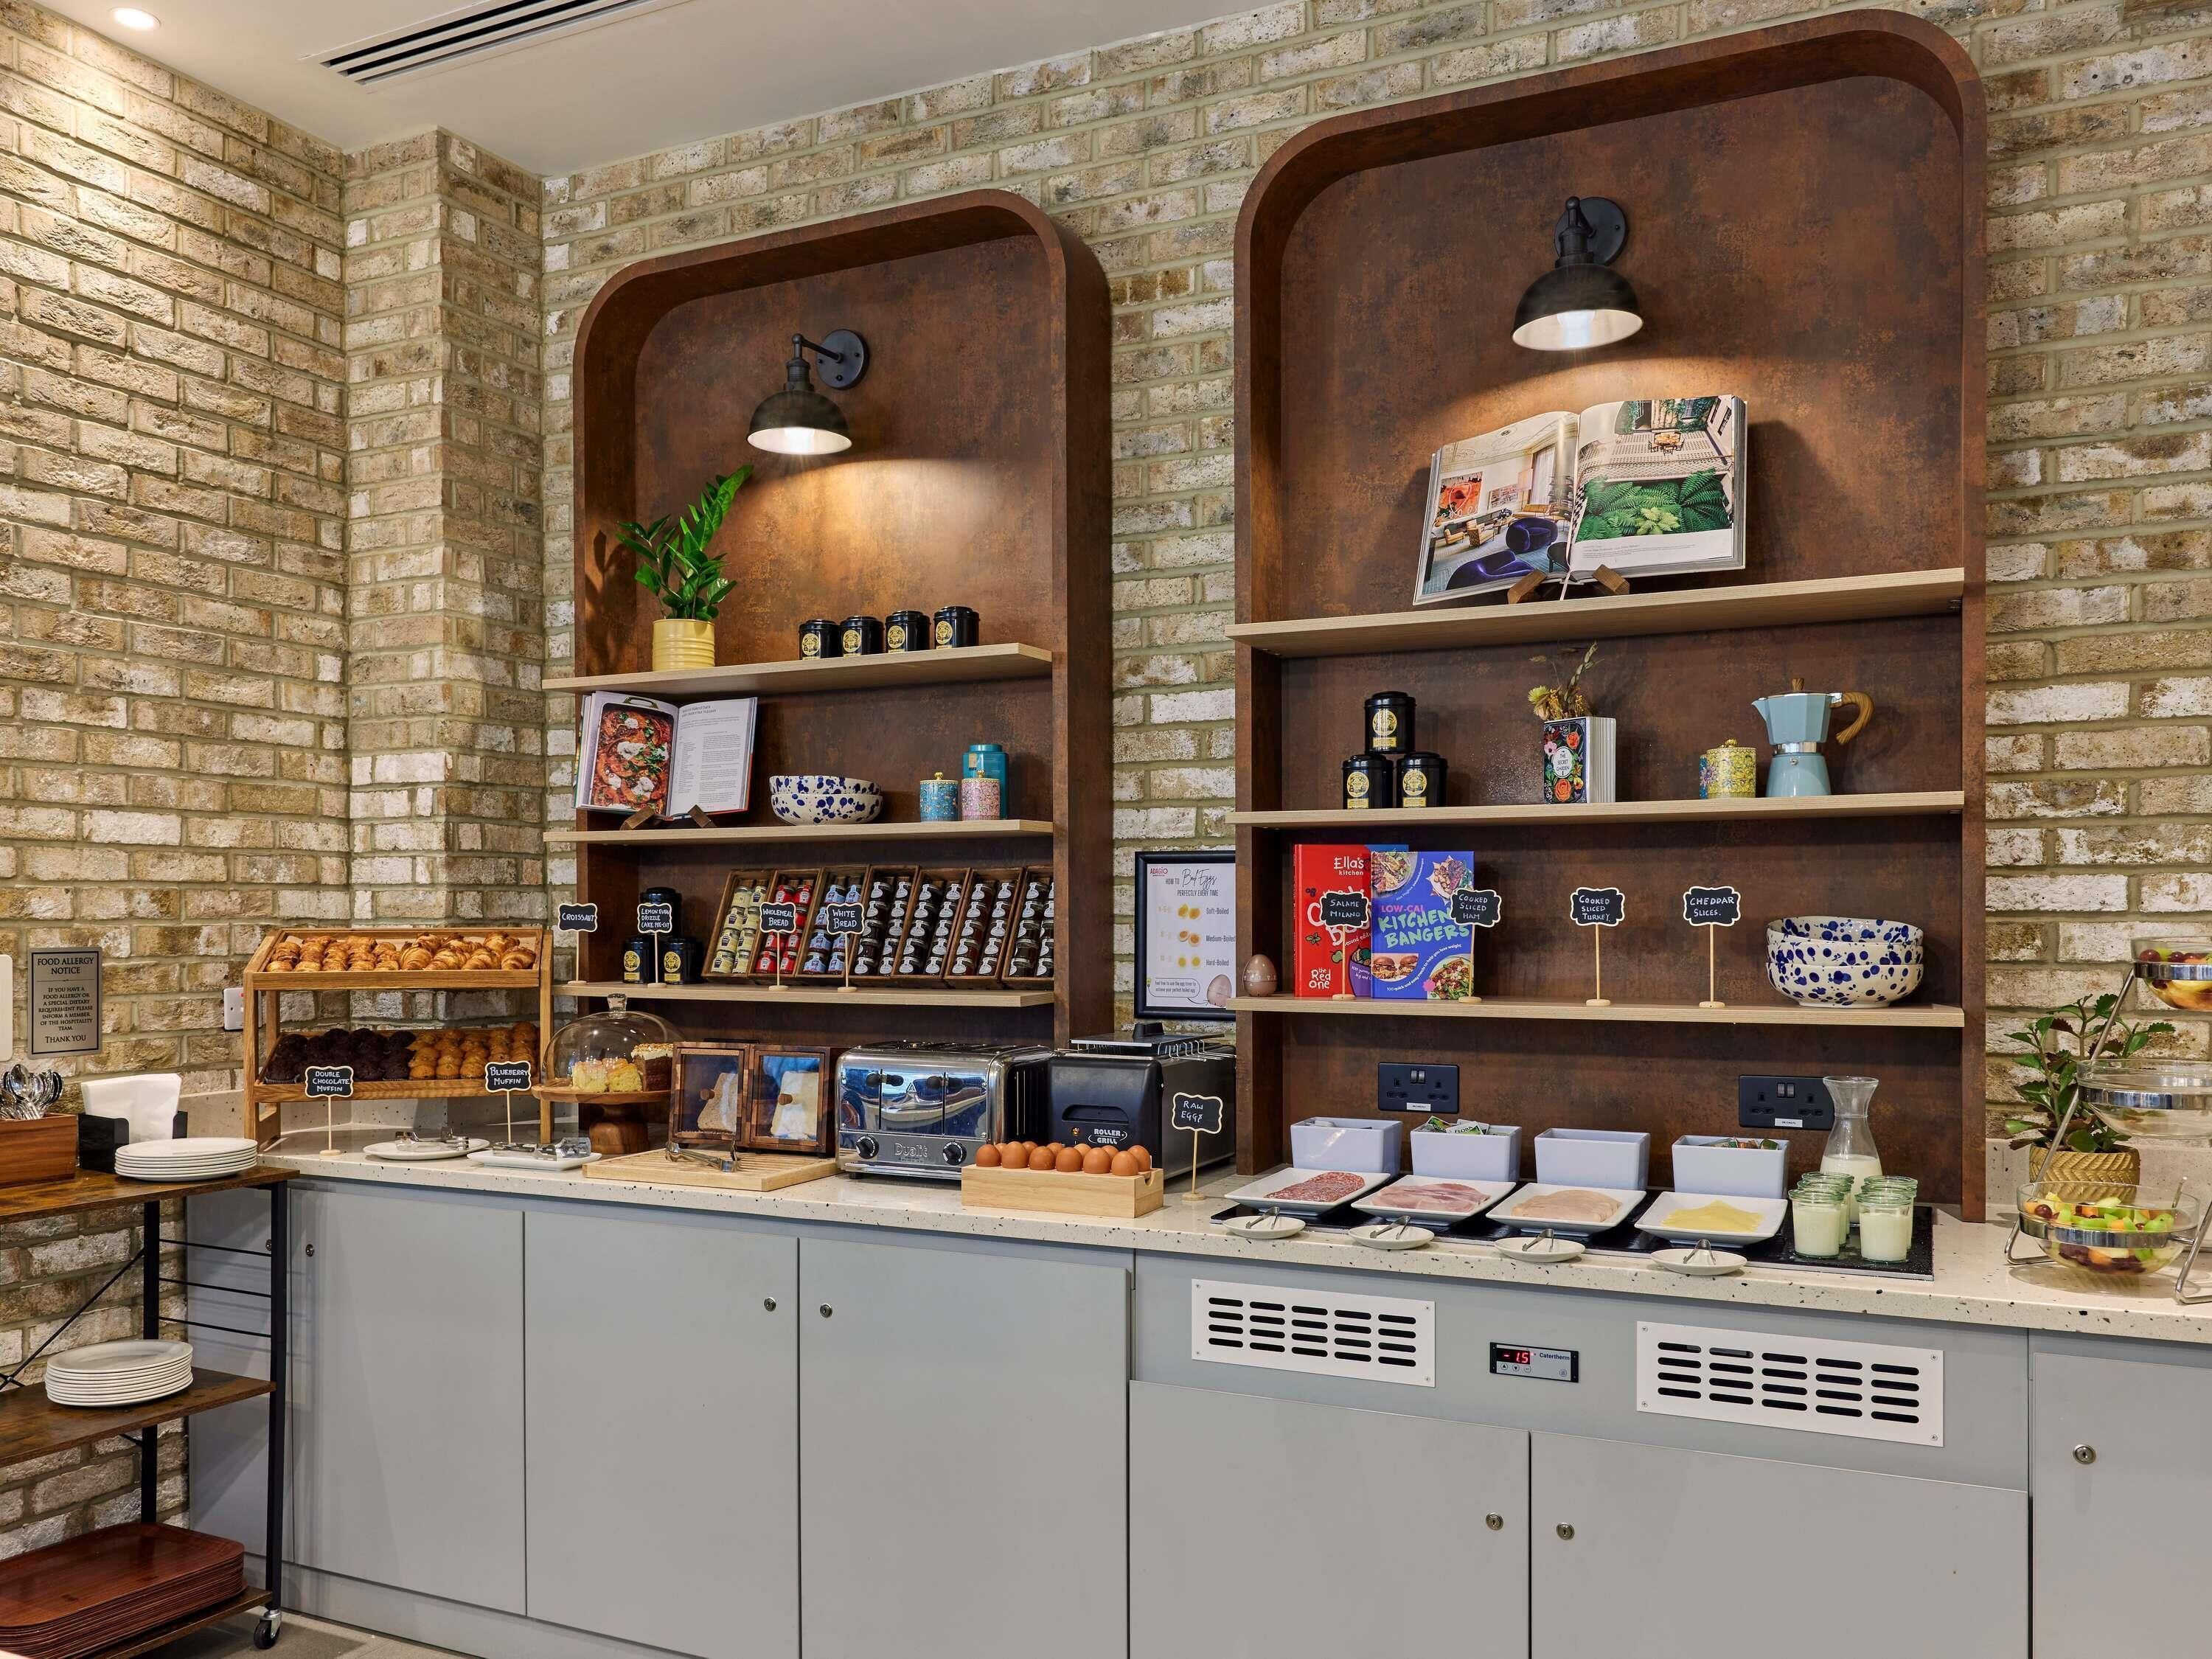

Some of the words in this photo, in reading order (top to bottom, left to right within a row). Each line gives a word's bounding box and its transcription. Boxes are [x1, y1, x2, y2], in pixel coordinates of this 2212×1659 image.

[1334, 855, 1364, 869] Ella's
[1458, 894, 1488, 903] COOKED
[1579, 894, 1610, 905] COOKED
[1689, 897, 1735, 905] CHEDDAR
[1329, 899, 1360, 908] SALAME
[1459, 902, 1487, 911] SLICED
[762, 908, 793, 917] WHOLEMEAL
[832, 909, 855, 918] WHITE
[1381, 904, 1424, 914] LOW-CAL
[1694, 908, 1722, 917] SLICES.
[561, 912, 595, 922] CROISSANT
[768, 917, 789, 926] BREAD
[1377, 907, 1450, 933] KITCHEN
[833, 918, 858, 929] BREAD
[1385, 924, 1470, 949] BANGERS
[38, 958, 60, 966] FOOD
[61, 956, 94, 965] ALLERGY
[51, 967, 81, 975] NOTICE
[1311, 968, 1332, 982] Red
[1411, 976, 1419, 984] easy
[45, 1035, 70, 1043] THANK
[490, 1066, 528, 1076] BLUEBERRY
[494, 1077, 521, 1085] MUFFIN
[1183, 1100, 1203, 1110] RAW
[1093, 1128, 1121, 1136] ROLLER
[894, 1143, 928, 1158] Dualit
[1539, 1352, 1570, 1361] Catertherm
